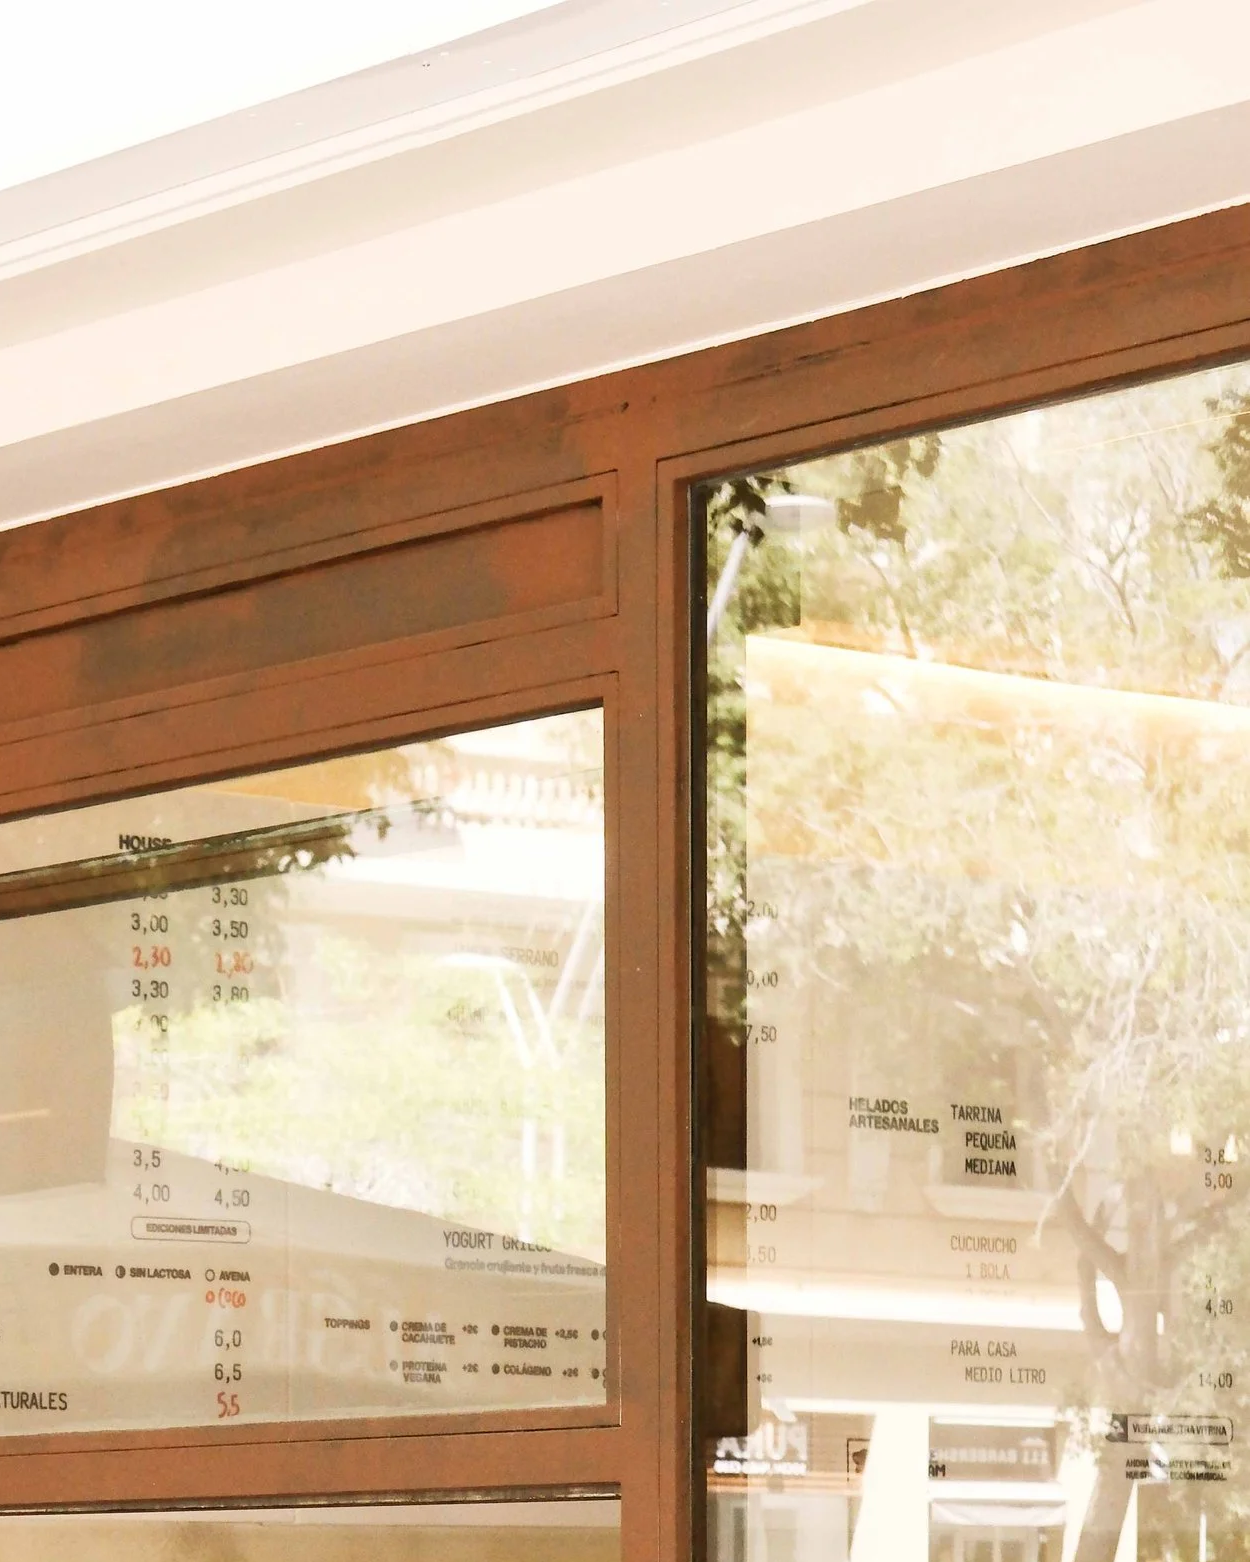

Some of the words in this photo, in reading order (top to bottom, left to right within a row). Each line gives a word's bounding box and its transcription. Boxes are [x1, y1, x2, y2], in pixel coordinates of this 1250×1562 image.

[131, 913, 168, 934] 3,00
[212, 919, 248, 939] 3,50
[131, 980, 168, 1001] 3,30
[848, 1096, 909, 1115] HELADOS
[950, 1104, 1002, 1124] TARRINA
[848, 1114, 940, 1134] ARTESANALES
[965, 1130, 1017, 1151] PEQUEÑA
[133, 1149, 161, 1170] 3,5
[965, 1157, 1017, 1177] MEDIANA
[1204, 1172, 1233, 1191] 5,00
[133, 1183, 170, 1203] 4,00
[214, 1188, 250, 1209] 4,50
[443, 1230, 494, 1250] YOGURT
[950, 1234, 1017, 1255] CUCURUCHO
[64, 1265, 103, 1277] ENTERA
[219, 1270, 251, 1282] AVENA
[214, 1329, 242, 1350] 6,0
[951, 1339, 981, 1357] PARA
[987, 1340, 1018, 1358] CASA
[214, 1362, 242, 1384] 6,5
[964, 1366, 1003, 1384] MEDIO
[1009, 1367, 1046, 1385] LITRO
